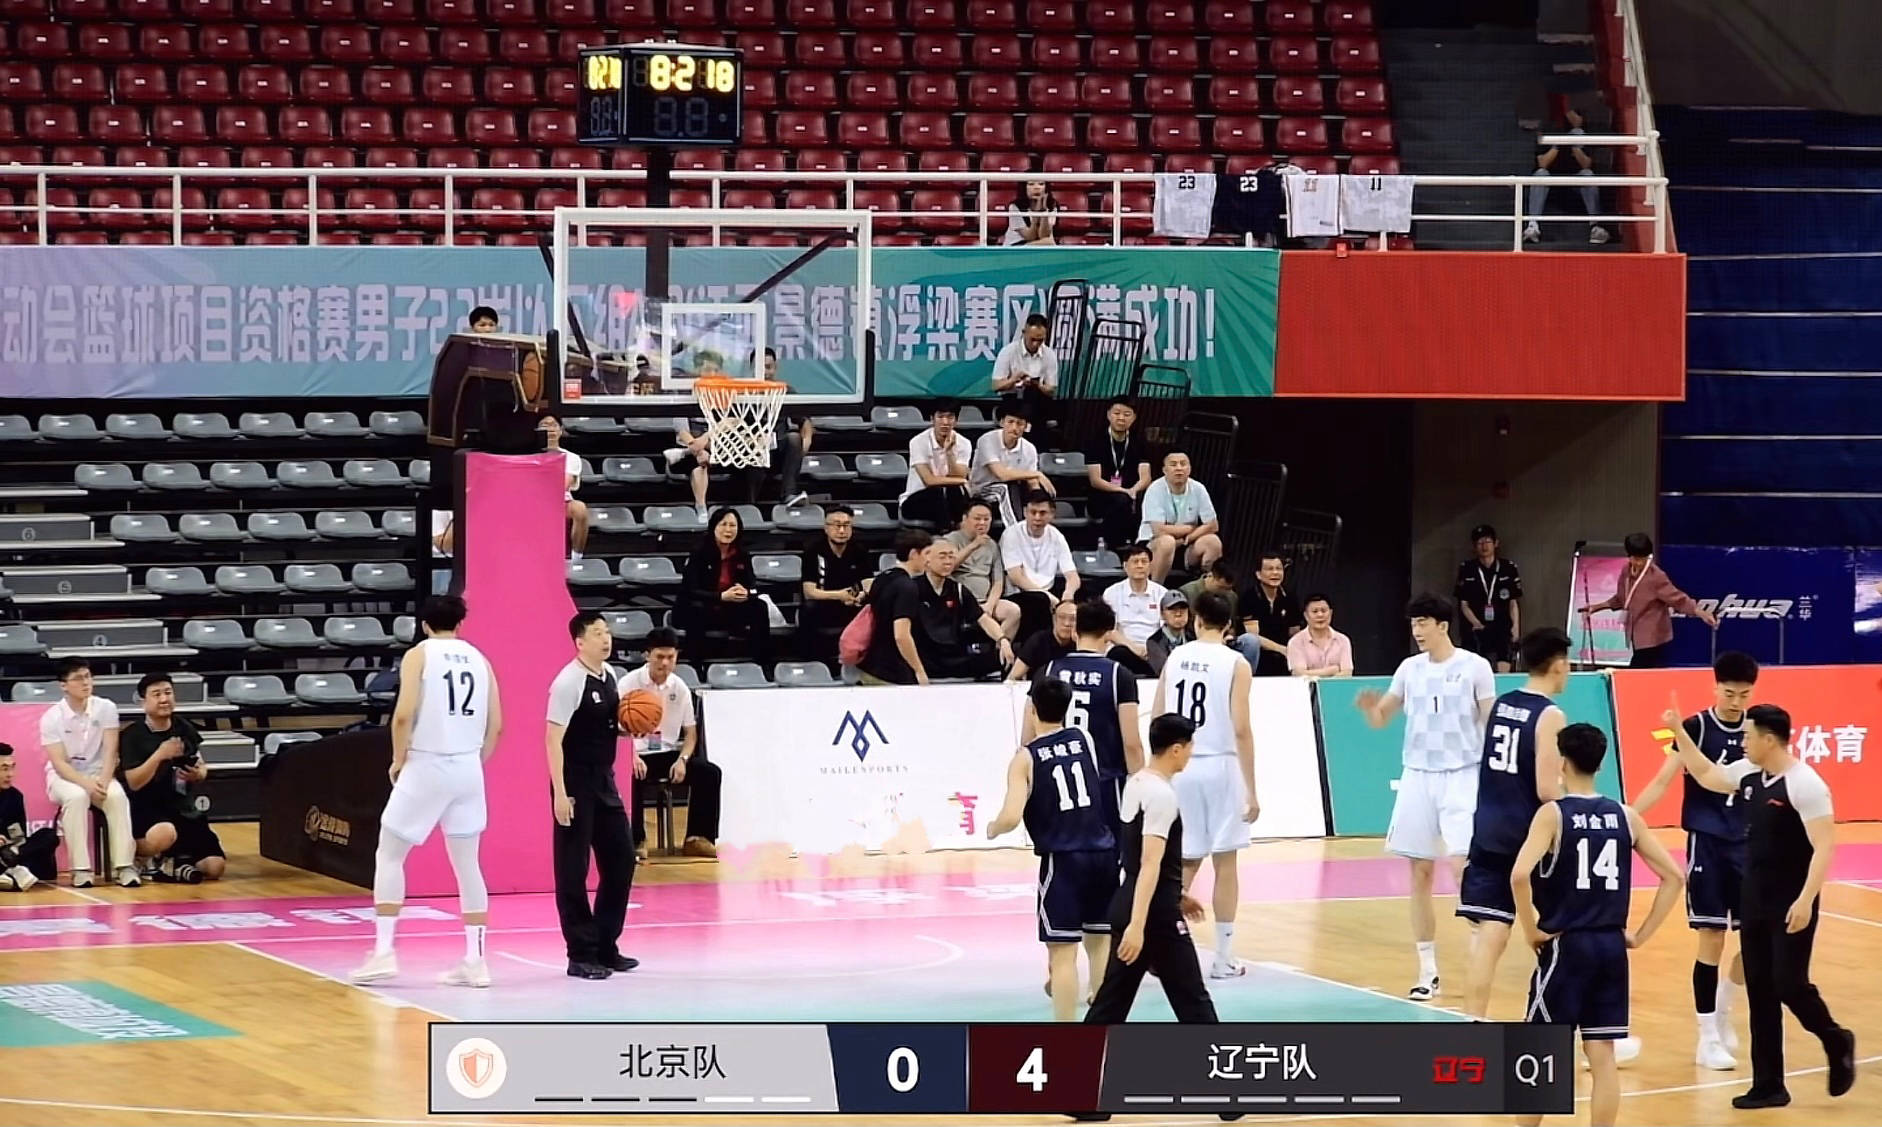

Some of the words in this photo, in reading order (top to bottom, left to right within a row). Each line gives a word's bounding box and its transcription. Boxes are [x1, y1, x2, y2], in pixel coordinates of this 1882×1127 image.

[1178, 175, 1196, 189] 23
[1240, 176, 1258, 192] 23
[1370, 177, 1382, 191] 11
[443, 669, 474, 716] 12
[1065, 691, 1090, 730] 6
[1175, 679, 1206, 728] 18
[1433, 696, 1438, 713] 1
[1489, 724, 1520, 774] 31
[1787, 724, 1868, 764] 体育
[1052, 761, 1091, 811] 11
[1576, 837, 1619, 891] 14
